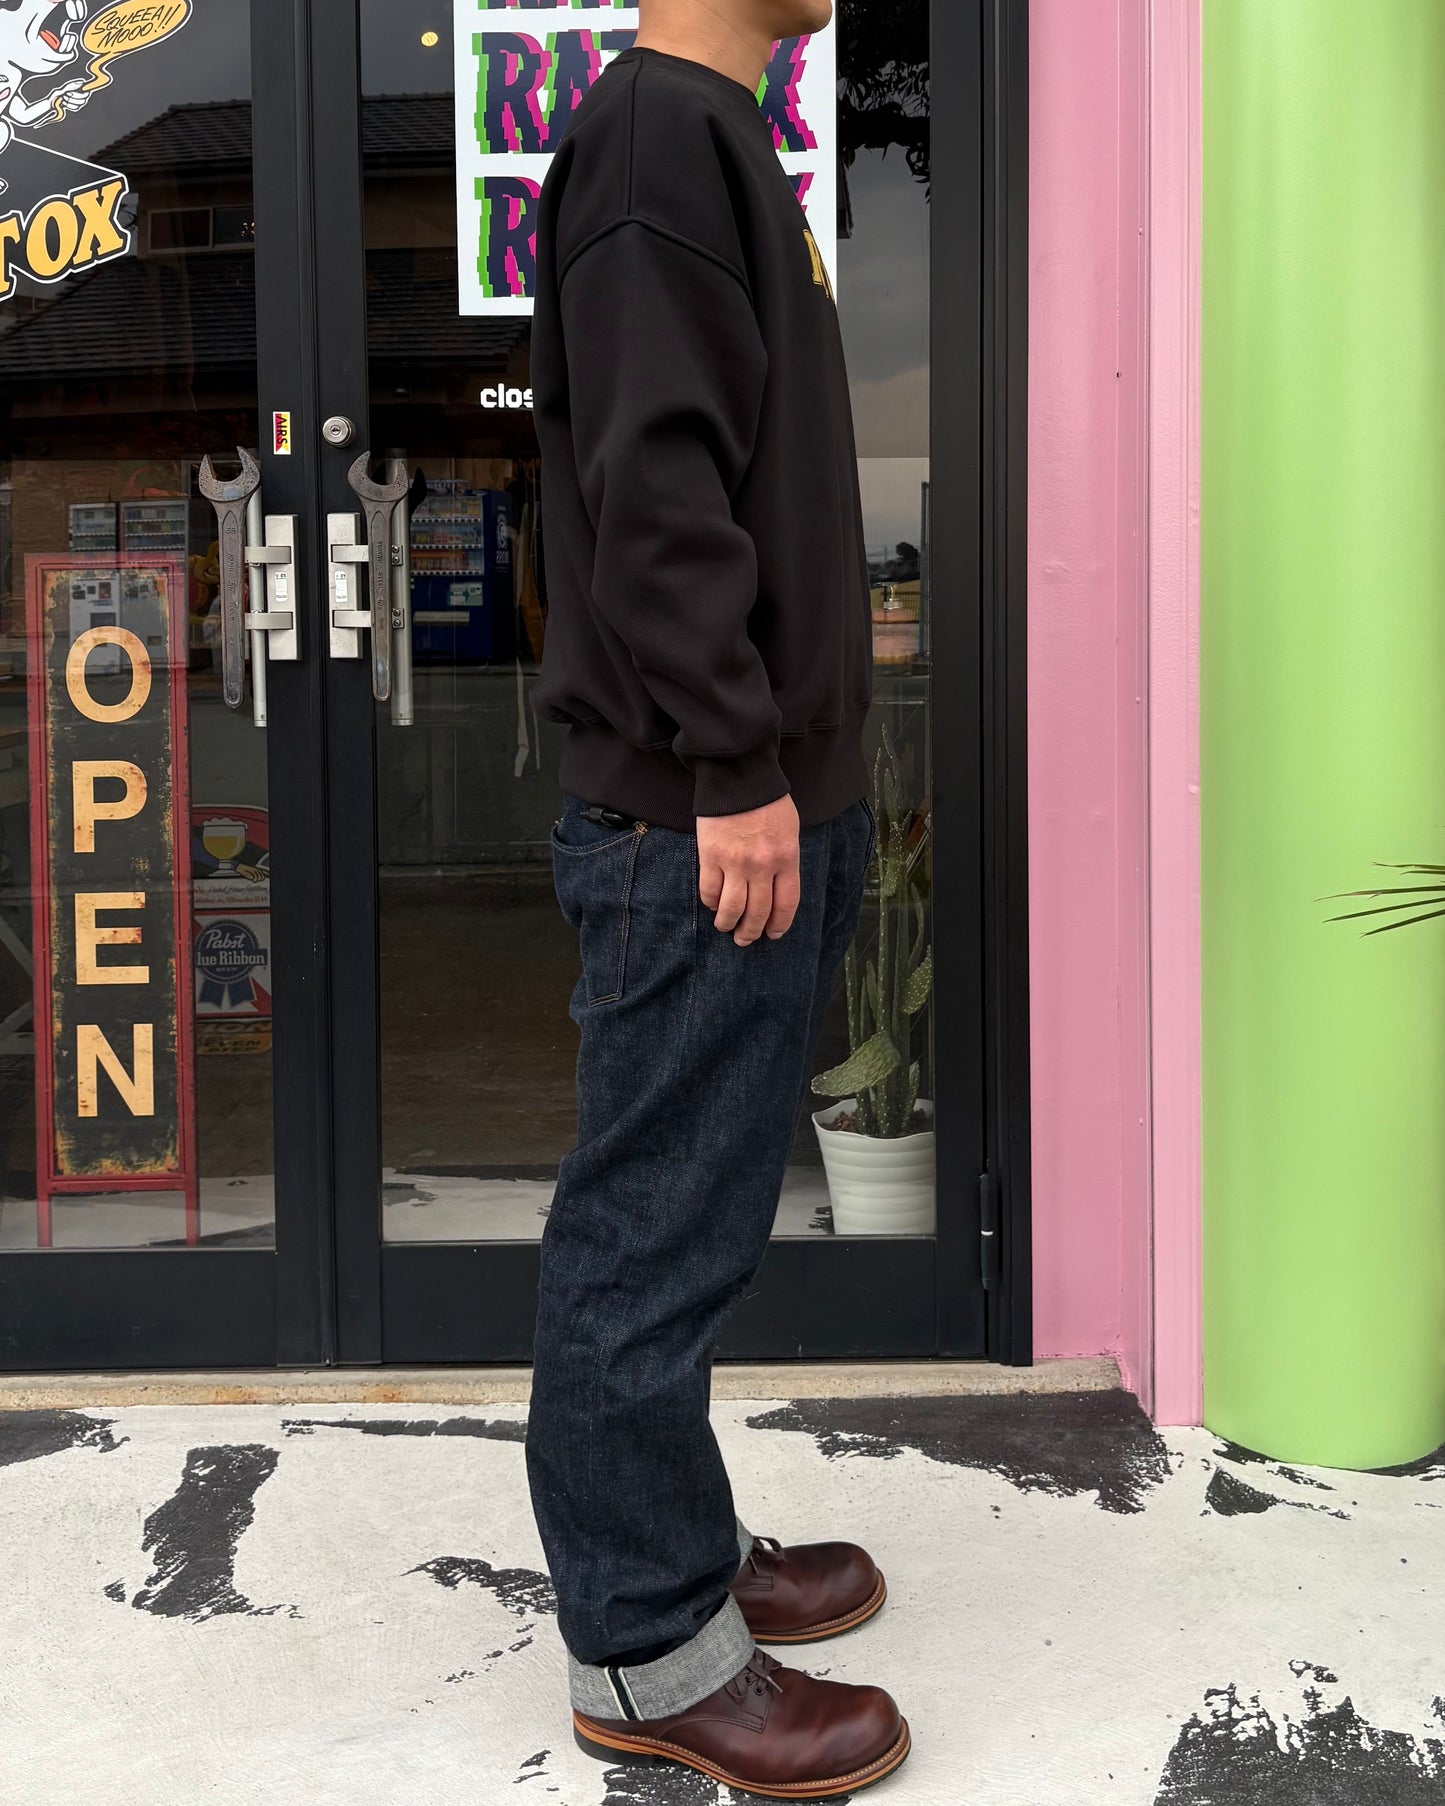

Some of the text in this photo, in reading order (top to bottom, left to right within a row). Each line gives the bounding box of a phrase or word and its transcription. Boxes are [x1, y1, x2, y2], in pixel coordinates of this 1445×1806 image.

[480, 383, 534, 408] clos
[65, 625, 155, 1118] OPEN
[205, 929, 246, 949] Pabst
[196, 950, 266, 966] lue Ribbon
